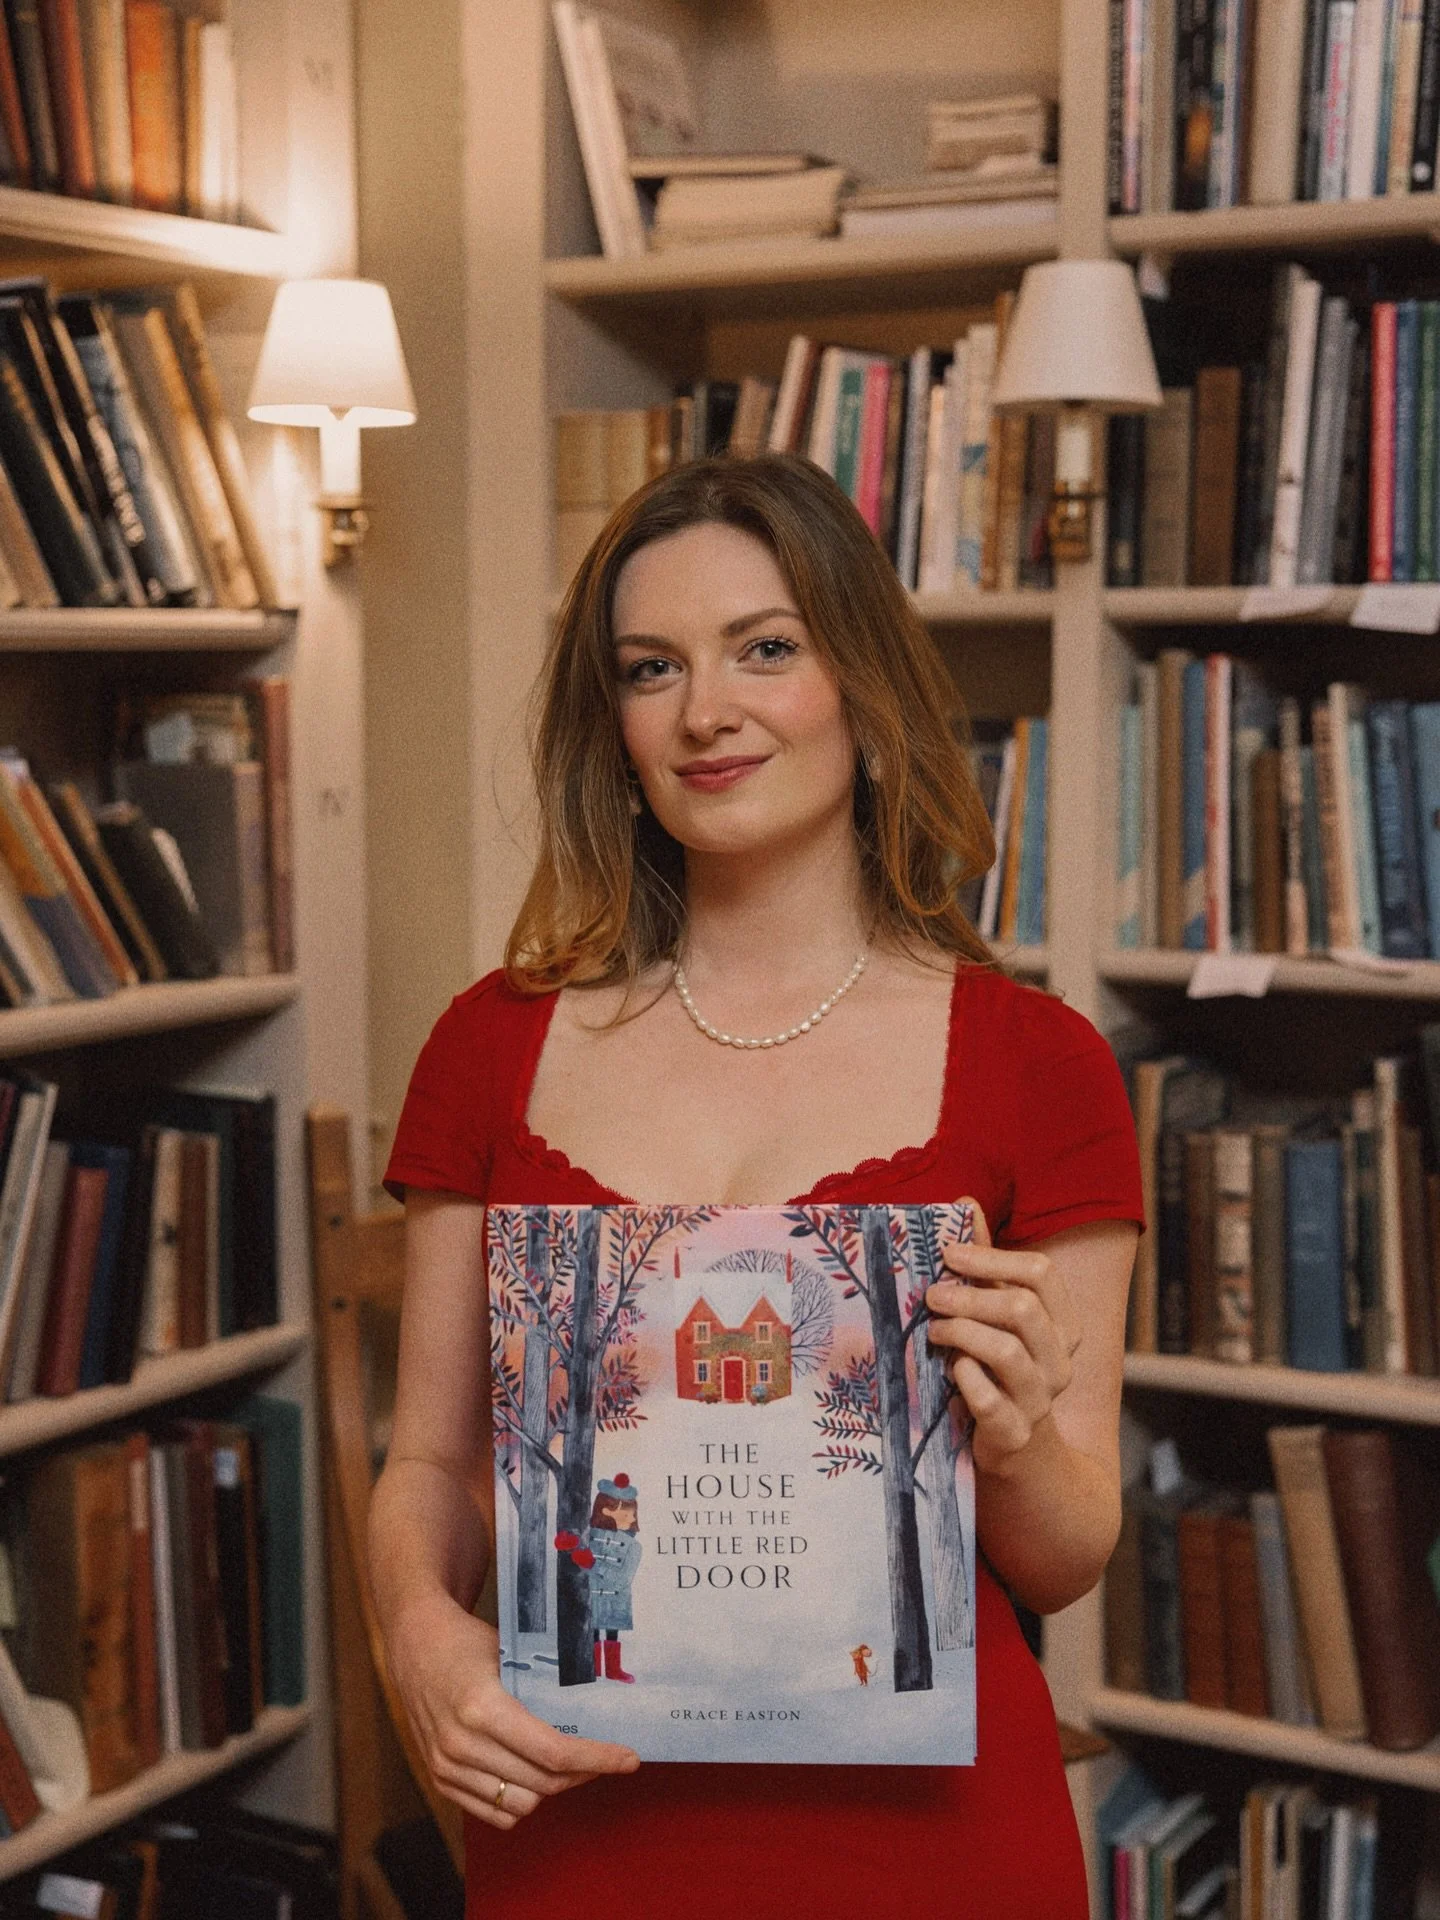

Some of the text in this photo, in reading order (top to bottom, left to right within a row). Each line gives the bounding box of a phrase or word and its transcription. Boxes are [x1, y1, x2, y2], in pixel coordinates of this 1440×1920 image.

[700, 1443, 759, 1464] THE
[667, 1474, 796, 1499] HOUSE
[672, 1510, 792, 1525] WITH THE
[657, 1536, 808, 1555] LITTLE RED
[677, 1565, 793, 1589] DOOR
[670, 1709, 801, 1721] GRACE EASTON
